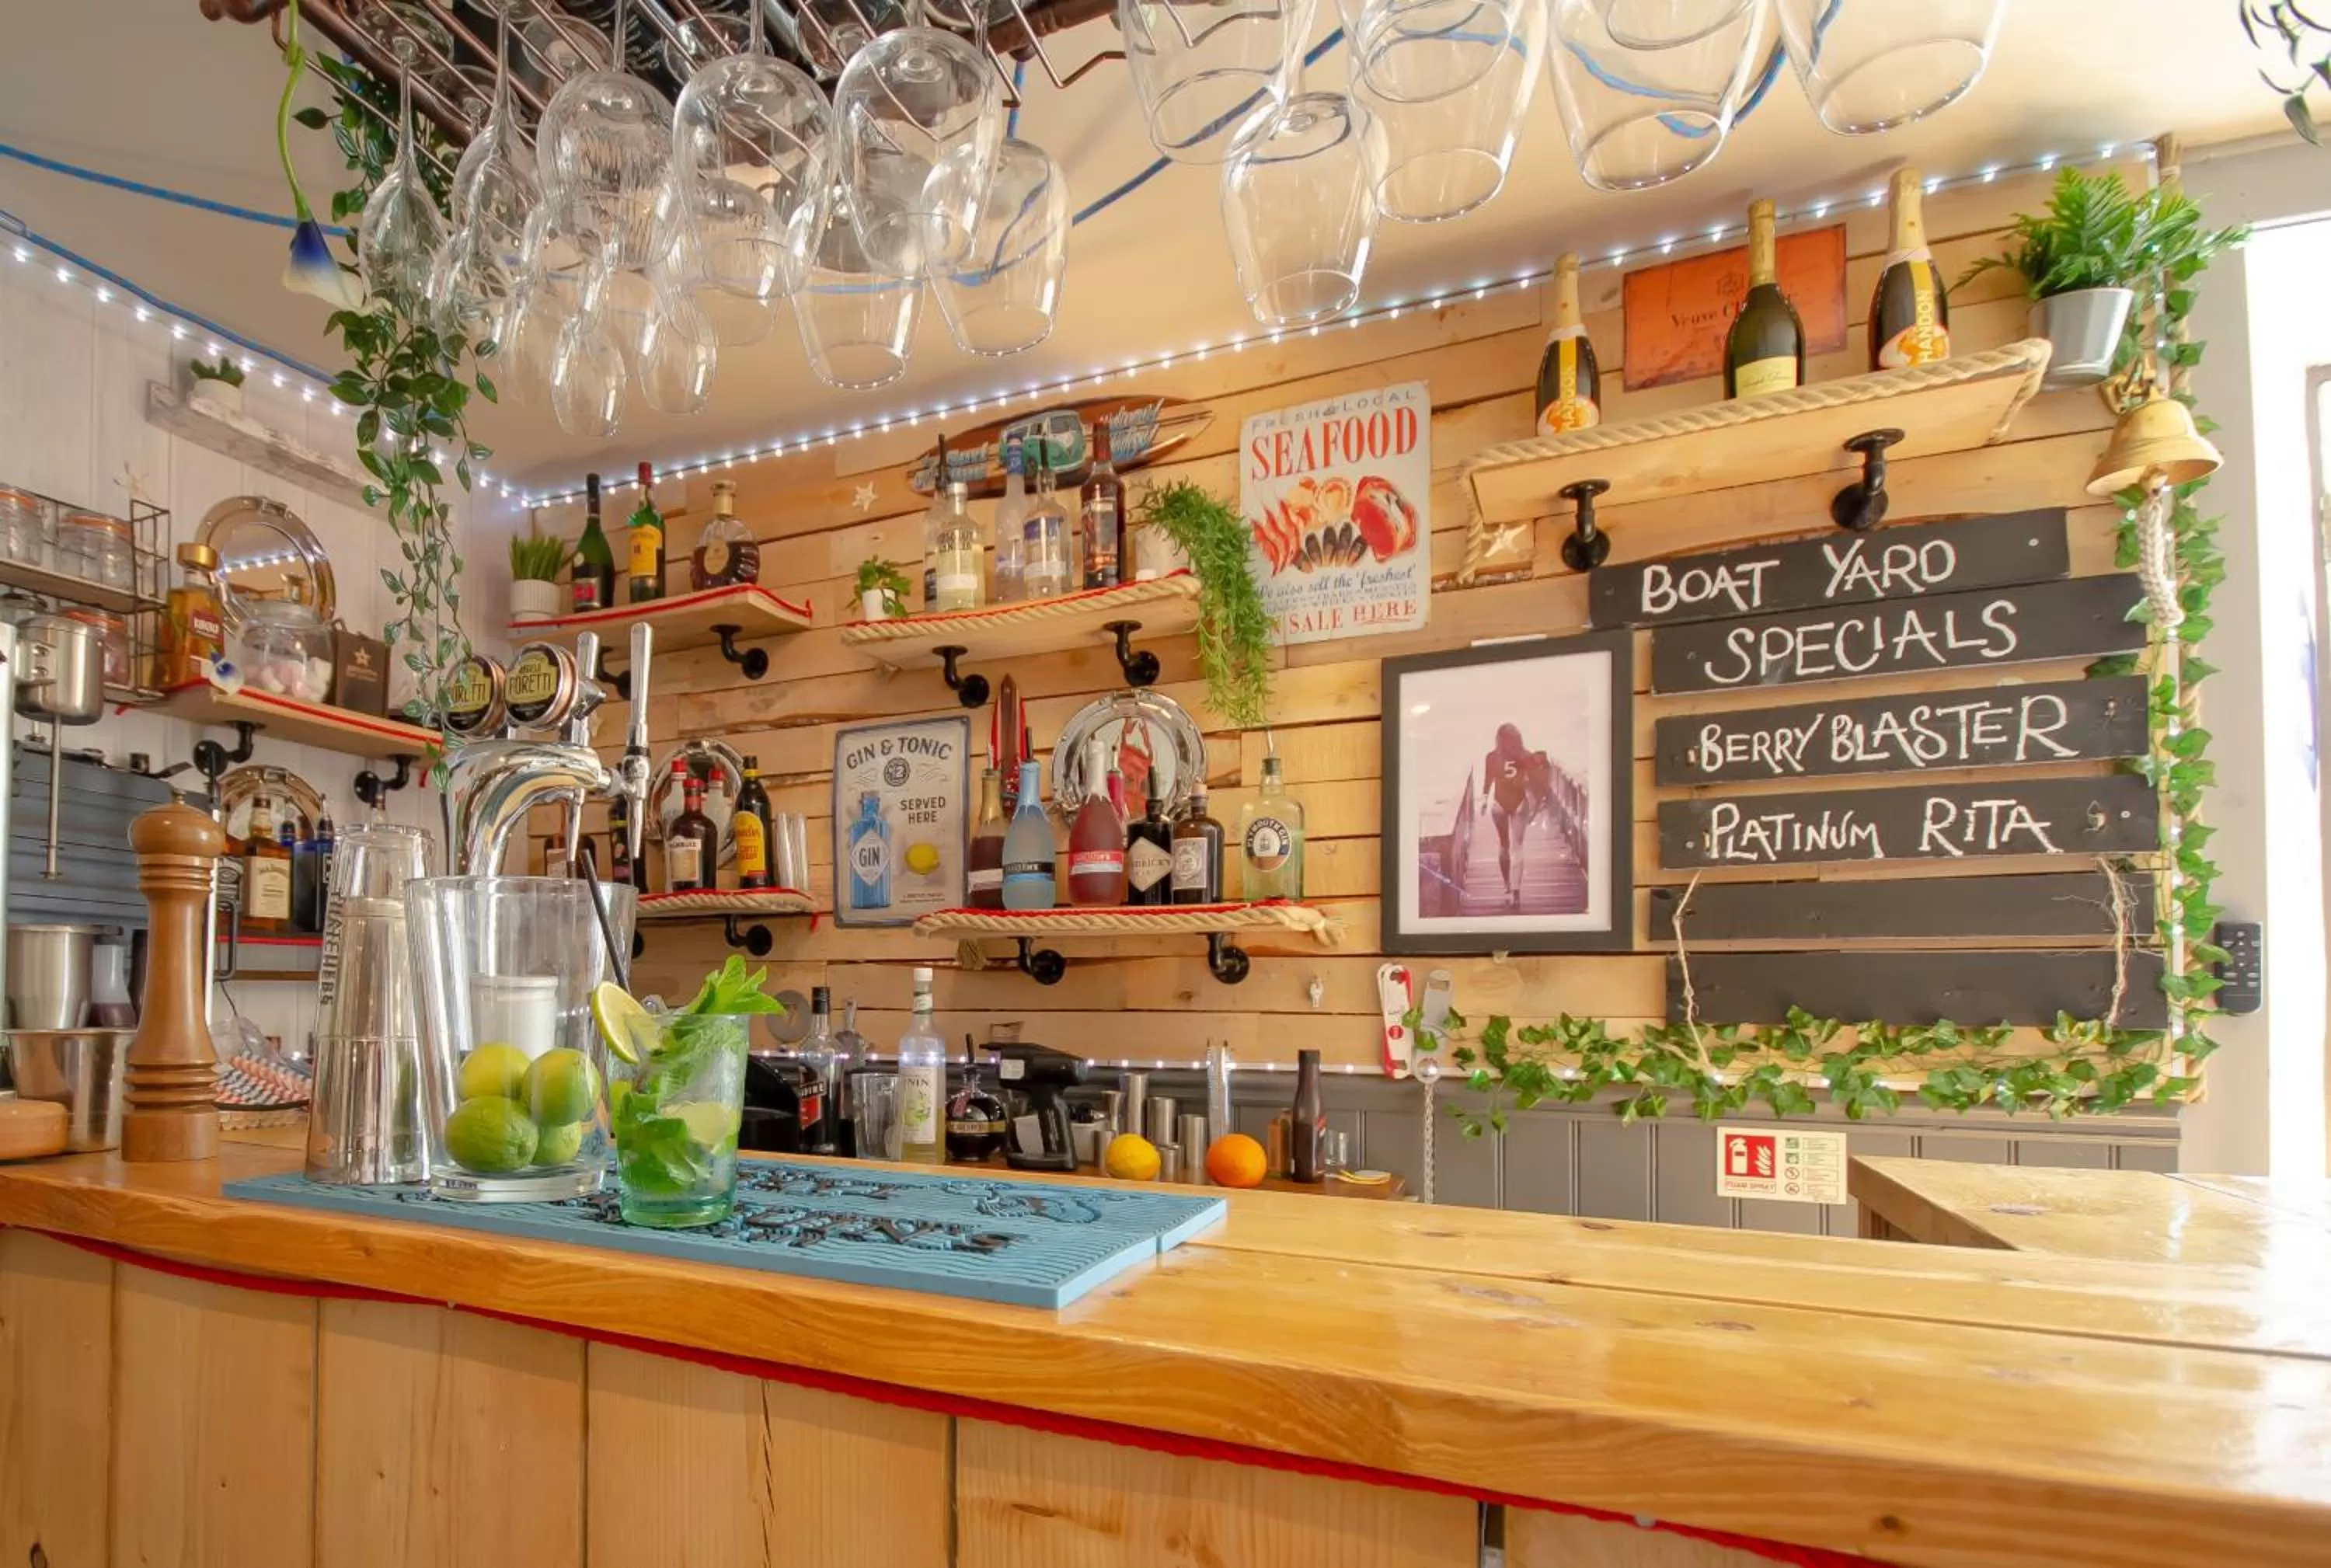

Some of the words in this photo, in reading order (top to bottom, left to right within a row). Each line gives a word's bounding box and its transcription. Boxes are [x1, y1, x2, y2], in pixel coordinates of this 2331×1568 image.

[1915, 290, 1935, 363] HANDON
[1343, 390, 1417, 412] LOCAL
[1251, 406, 1418, 483] SEAFOOD
[1334, 573, 1354, 589] the
[1641, 559, 1780, 615] BOAT
[1821, 538, 1956, 599] YARD
[1288, 607, 1343, 635] SALE
[1354, 599, 1417, 623] HERE
[1703, 599, 2018, 685] SPECIALS
[1699, 713, 1824, 775] BERRY
[1829, 693, 2081, 770] BLASTER
[846, 742, 876, 770] GIN
[880, 739, 894, 756] &
[897, 737, 953, 761] TONIC
[1503, 760, 1517, 778] 5
[900, 796, 946, 811] SERVED
[908, 810, 939, 824] HERE
[1709, 802, 1886, 860] PLATINUM
[1918, 796, 2065, 856] RITA
[859, 846, 881, 867] GIN
